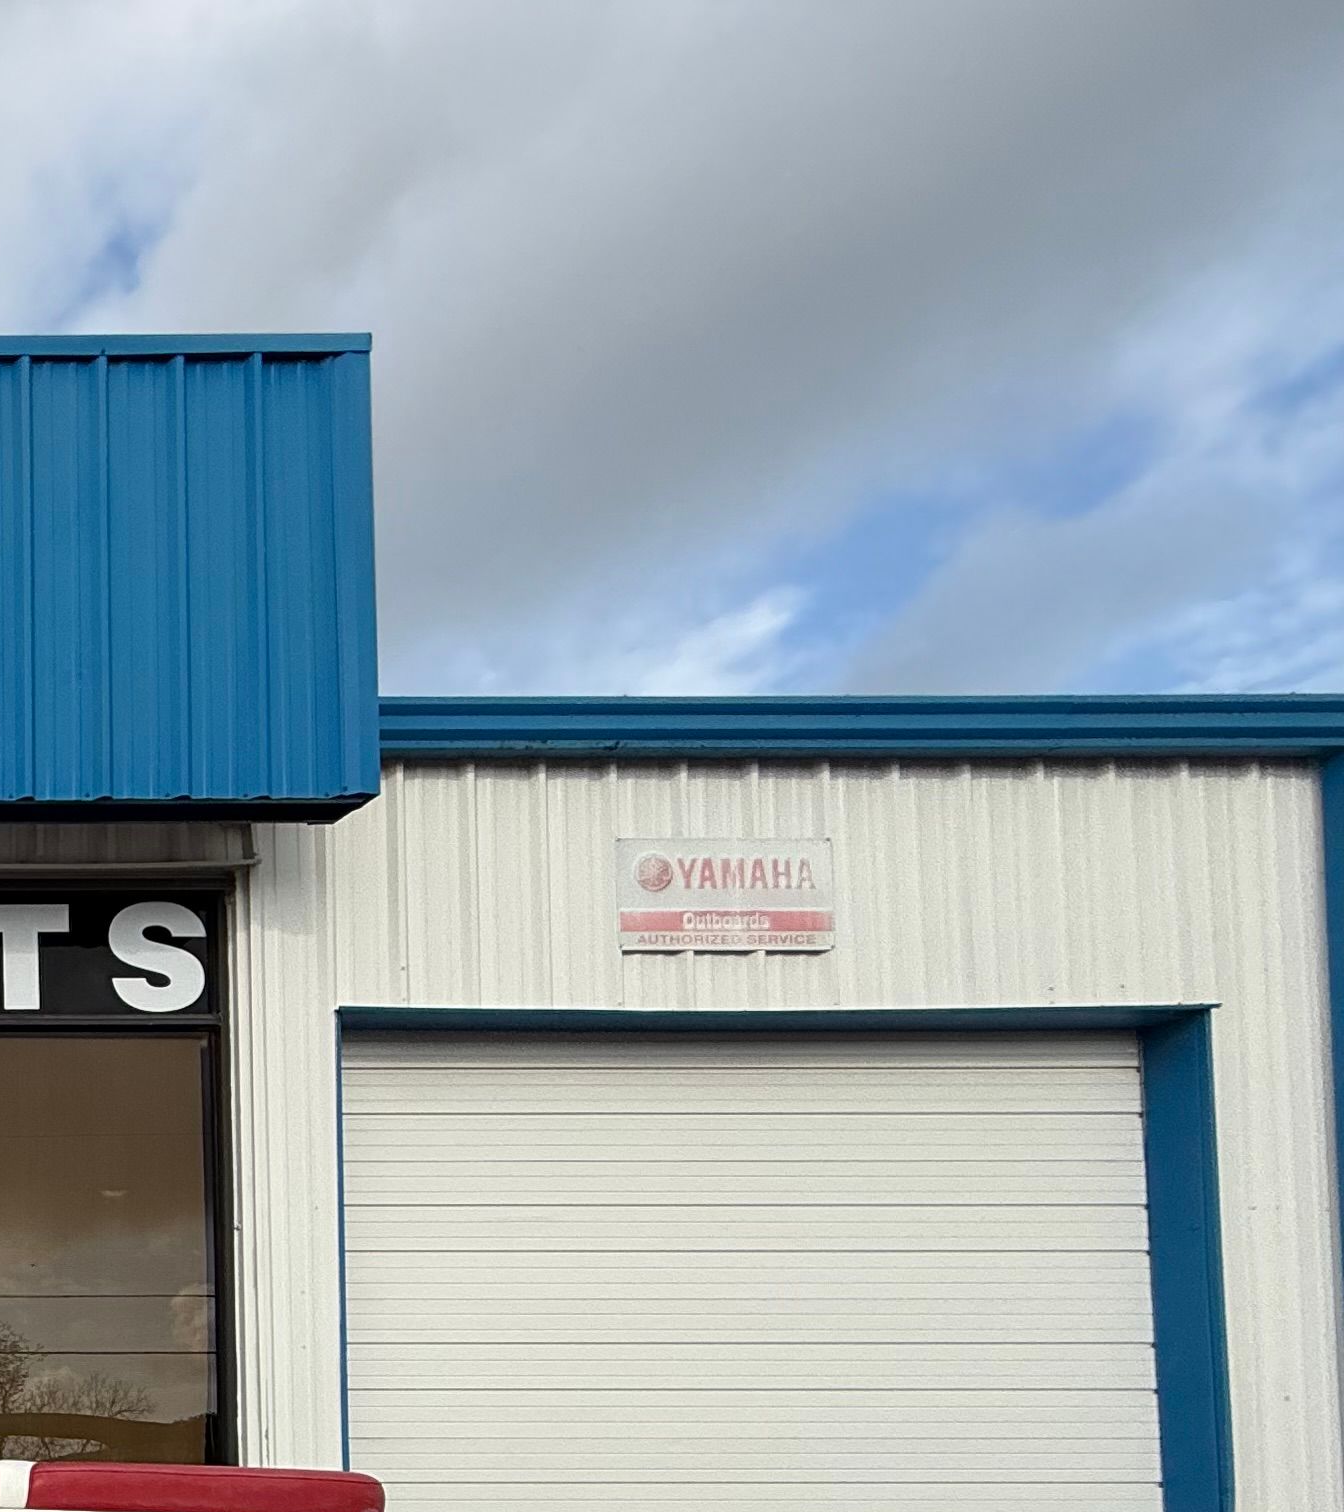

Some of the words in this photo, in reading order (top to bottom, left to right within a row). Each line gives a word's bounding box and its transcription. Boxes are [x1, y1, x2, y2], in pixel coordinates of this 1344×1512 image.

[676, 857, 816, 890] YAMAHA
[682, 912, 770, 930] Outboards
[637, 933, 742, 945] AUTHORIZED
[746, 934, 817, 945] SERVICE
